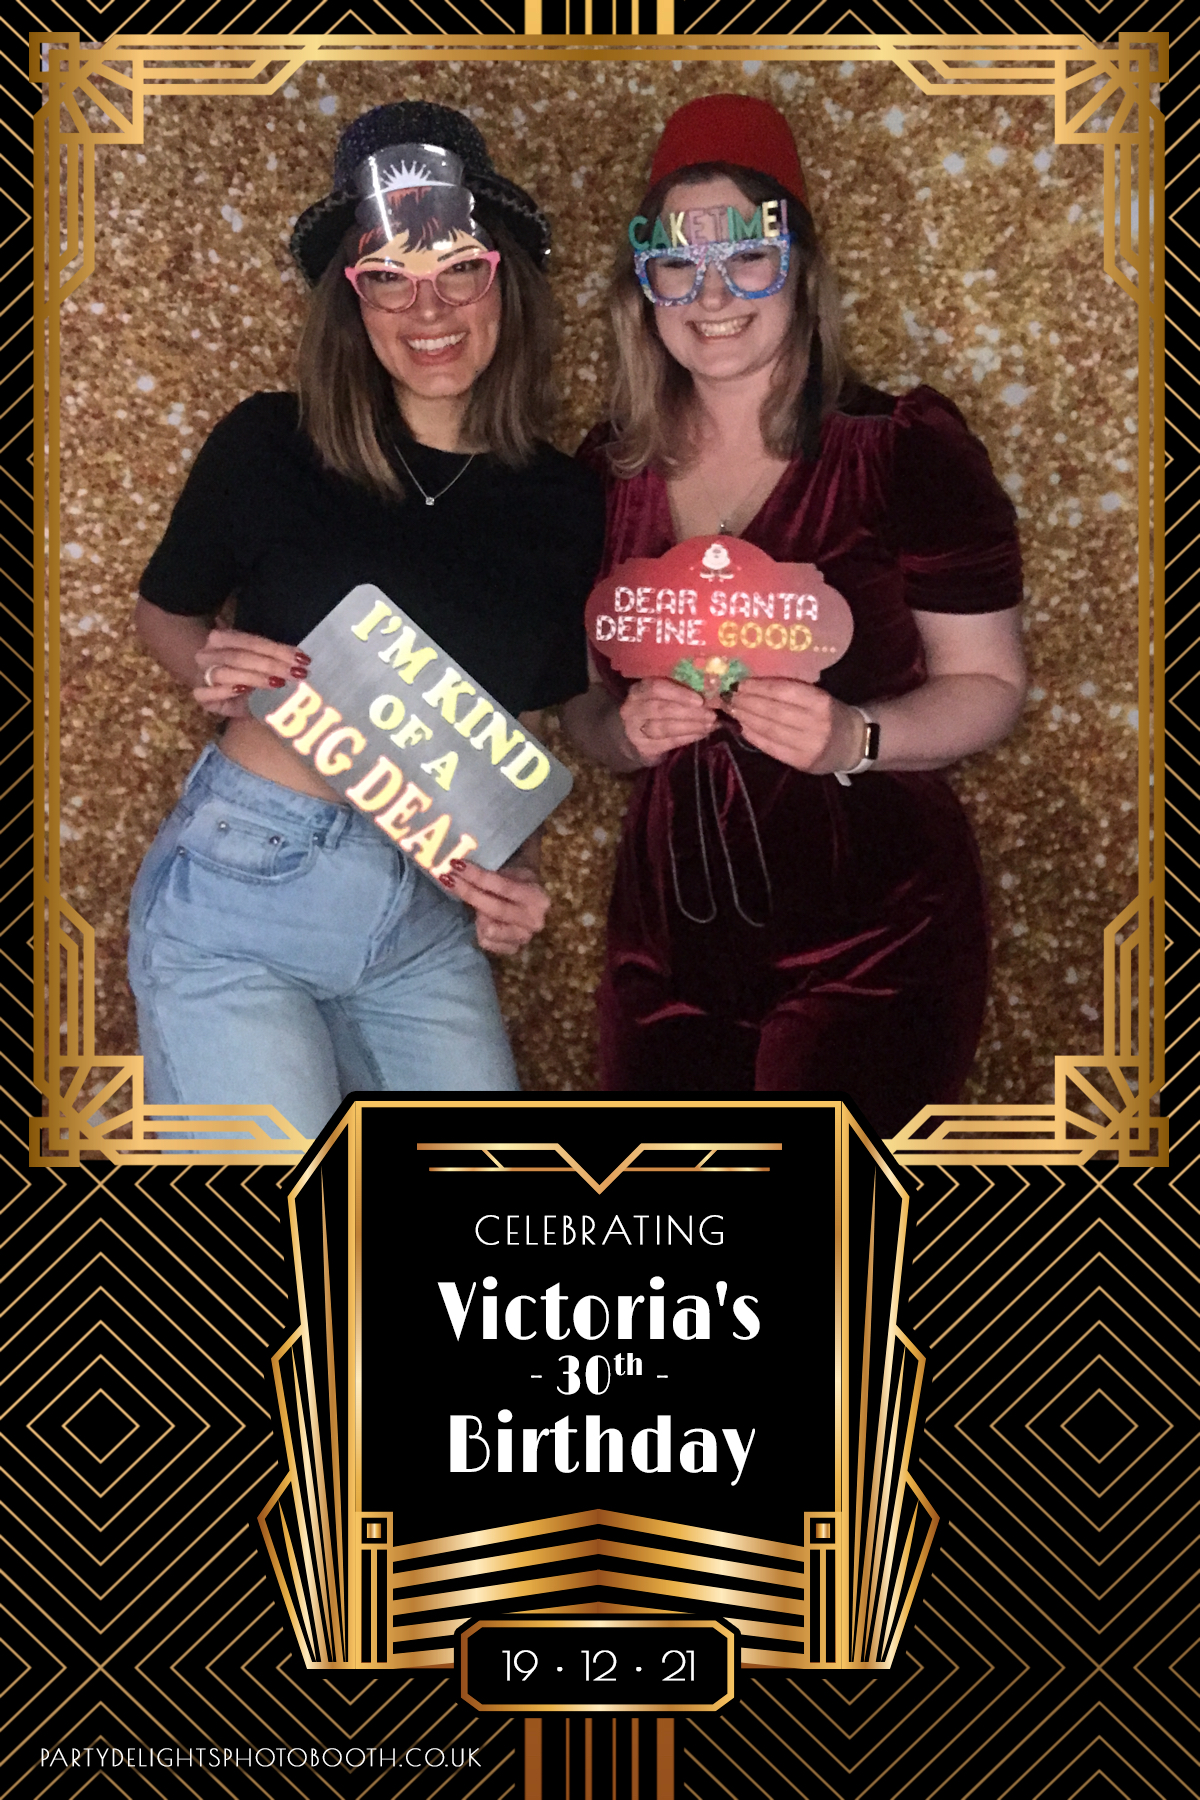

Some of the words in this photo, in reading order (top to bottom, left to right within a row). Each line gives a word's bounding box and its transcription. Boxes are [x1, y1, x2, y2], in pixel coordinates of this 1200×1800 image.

[595, 615, 706, 646] DEFINE
[717, 620, 836, 653] GOOD...
[614, 586, 698, 615] DEAR
[709, 590, 818, 621] SANTA
[264, 681, 368, 777] BIG
[350, 599, 438, 685] I'M
[421, 666, 551, 791] KIND
[368, 693, 434, 750] OF
[420, 750, 460, 791] A
